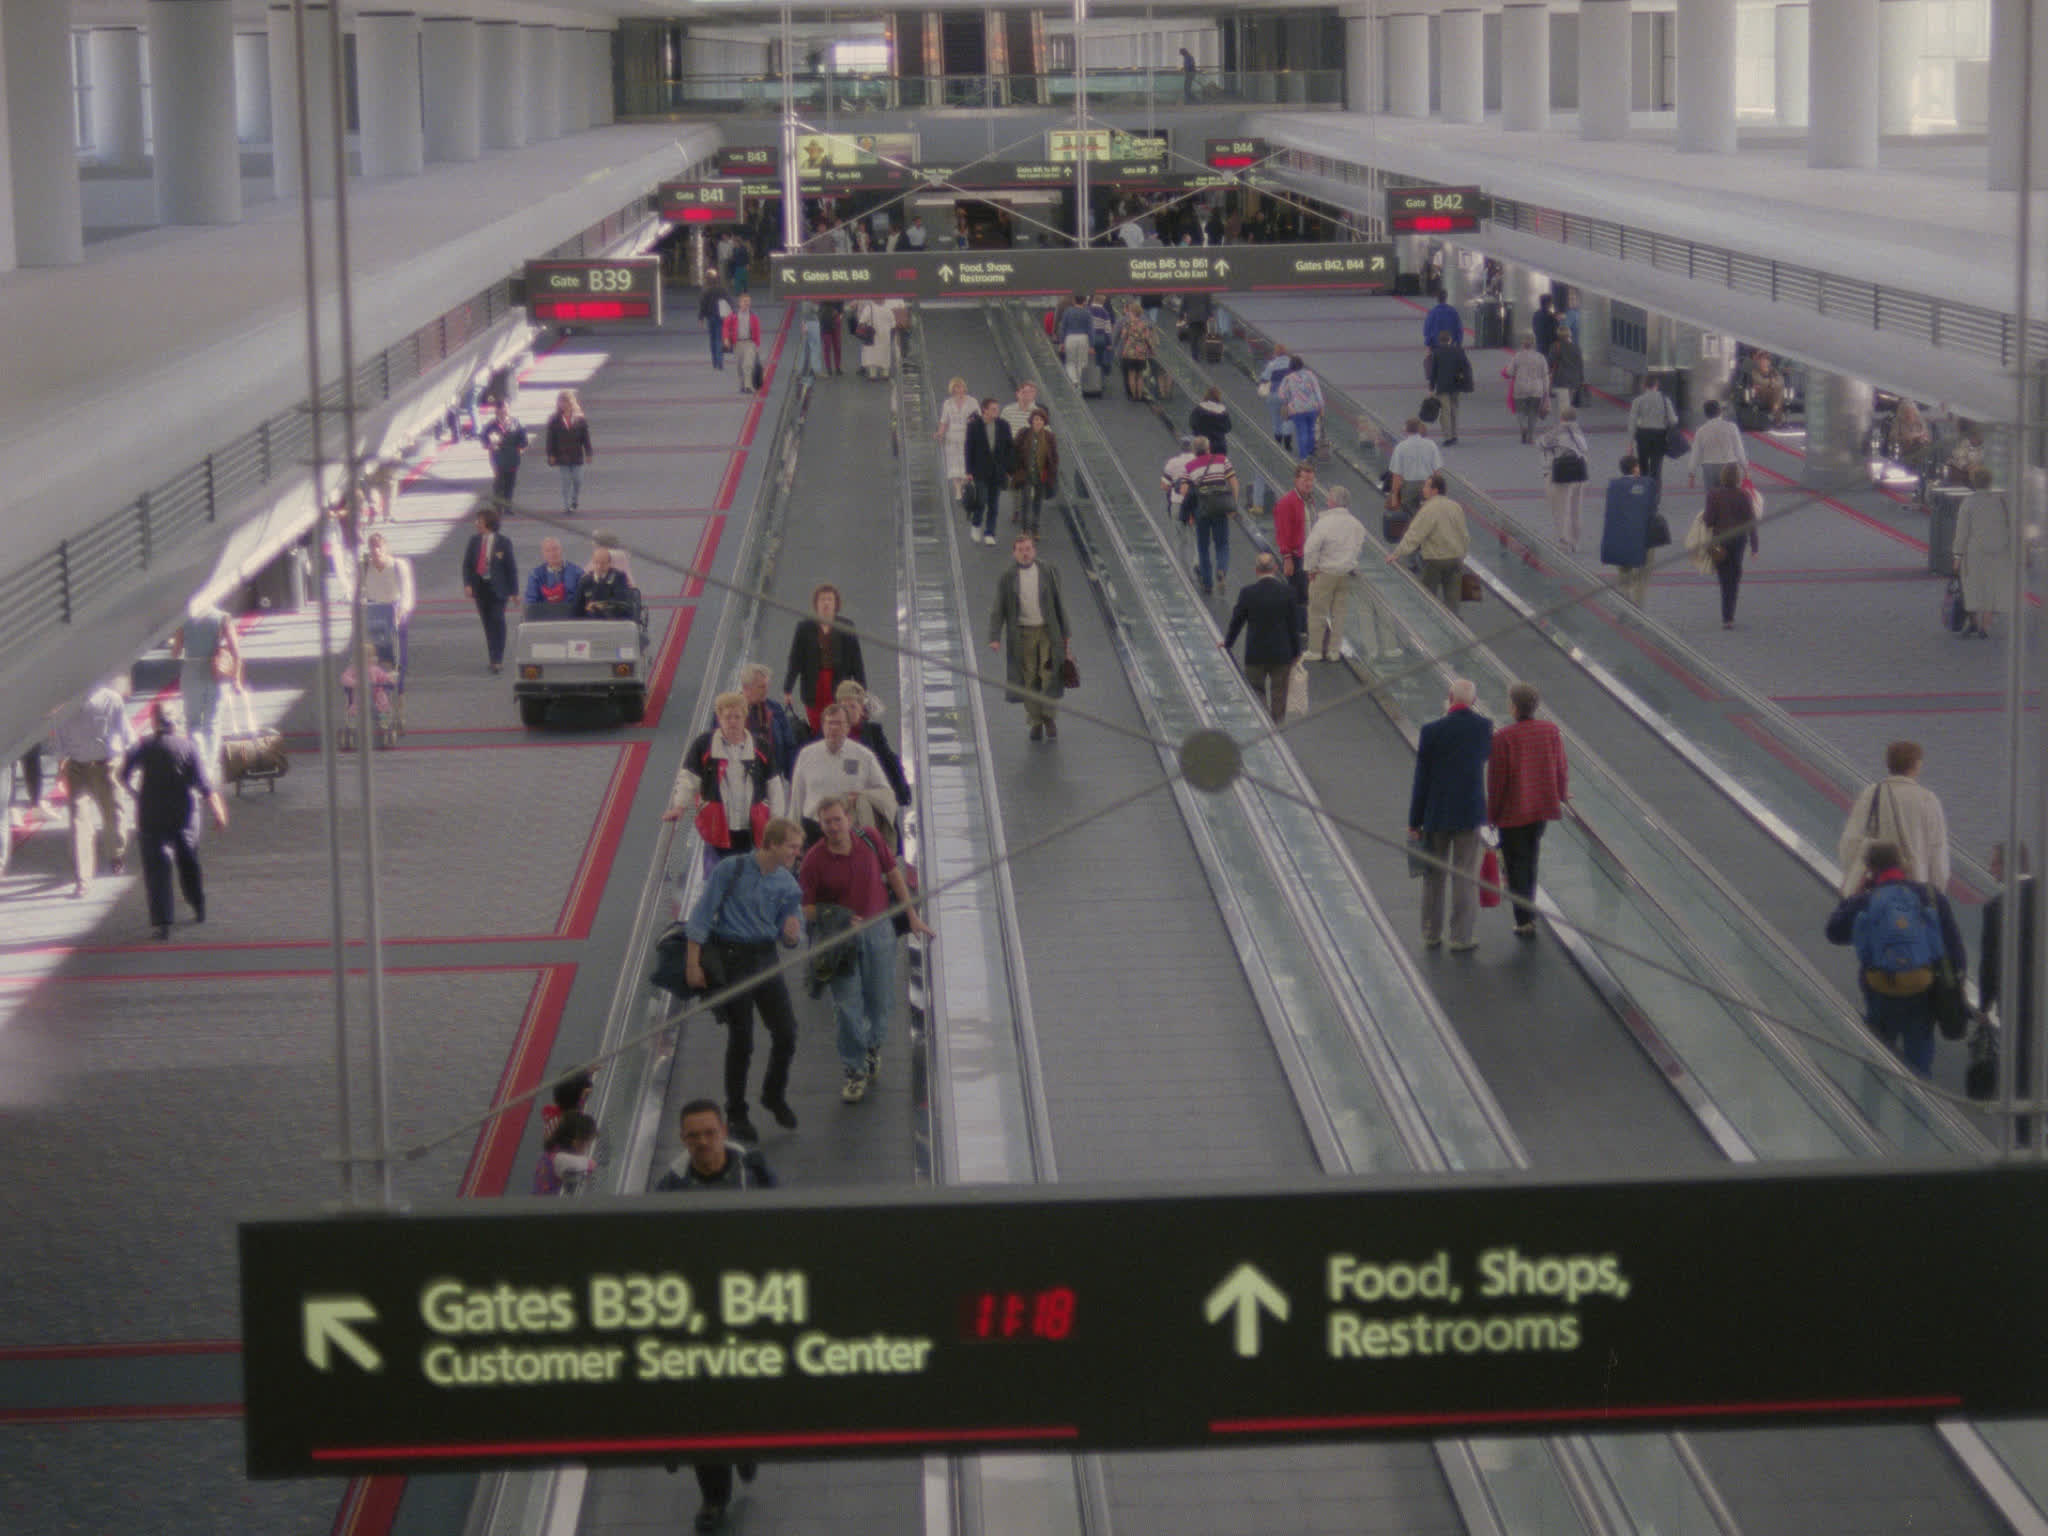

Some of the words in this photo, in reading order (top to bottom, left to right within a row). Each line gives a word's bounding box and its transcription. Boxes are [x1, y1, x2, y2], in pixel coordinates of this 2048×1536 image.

[1233, 142, 1253, 154] B44
[747, 151, 768, 162] B43
[676, 190, 695, 200] Gate
[700, 188, 724, 202] B41
[1405, 198, 1427, 208] Gate
[1432, 193, 1463, 210] B42
[1130, 259, 1157, 270] Gates
[1158, 259, 1177, 269] B45
[1179, 259, 1191, 269] to
[1192, 258, 1208, 269] B61
[1295, 261, 1322, 271] Gates
[1346, 259, 1365, 270] B44
[550, 274, 580, 287] Gate
[588, 268, 633, 292] B39
[802, 271, 830, 281] Gates
[851, 269, 870, 281] B43
[1326, 1252, 1462, 1304] Food,
[1477, 1247, 1632, 1305] Shops,
[420, 1279, 577, 1334] Gates
[590, 1274, 706, 1335] B39,
[720, 1271, 808, 1326] B41
[1327, 1310, 1582, 1360] Restrooms
[421, 1342, 622, 1386] Customer
[636, 1333, 784, 1380] Service
[794, 1331, 934, 1376] Center
